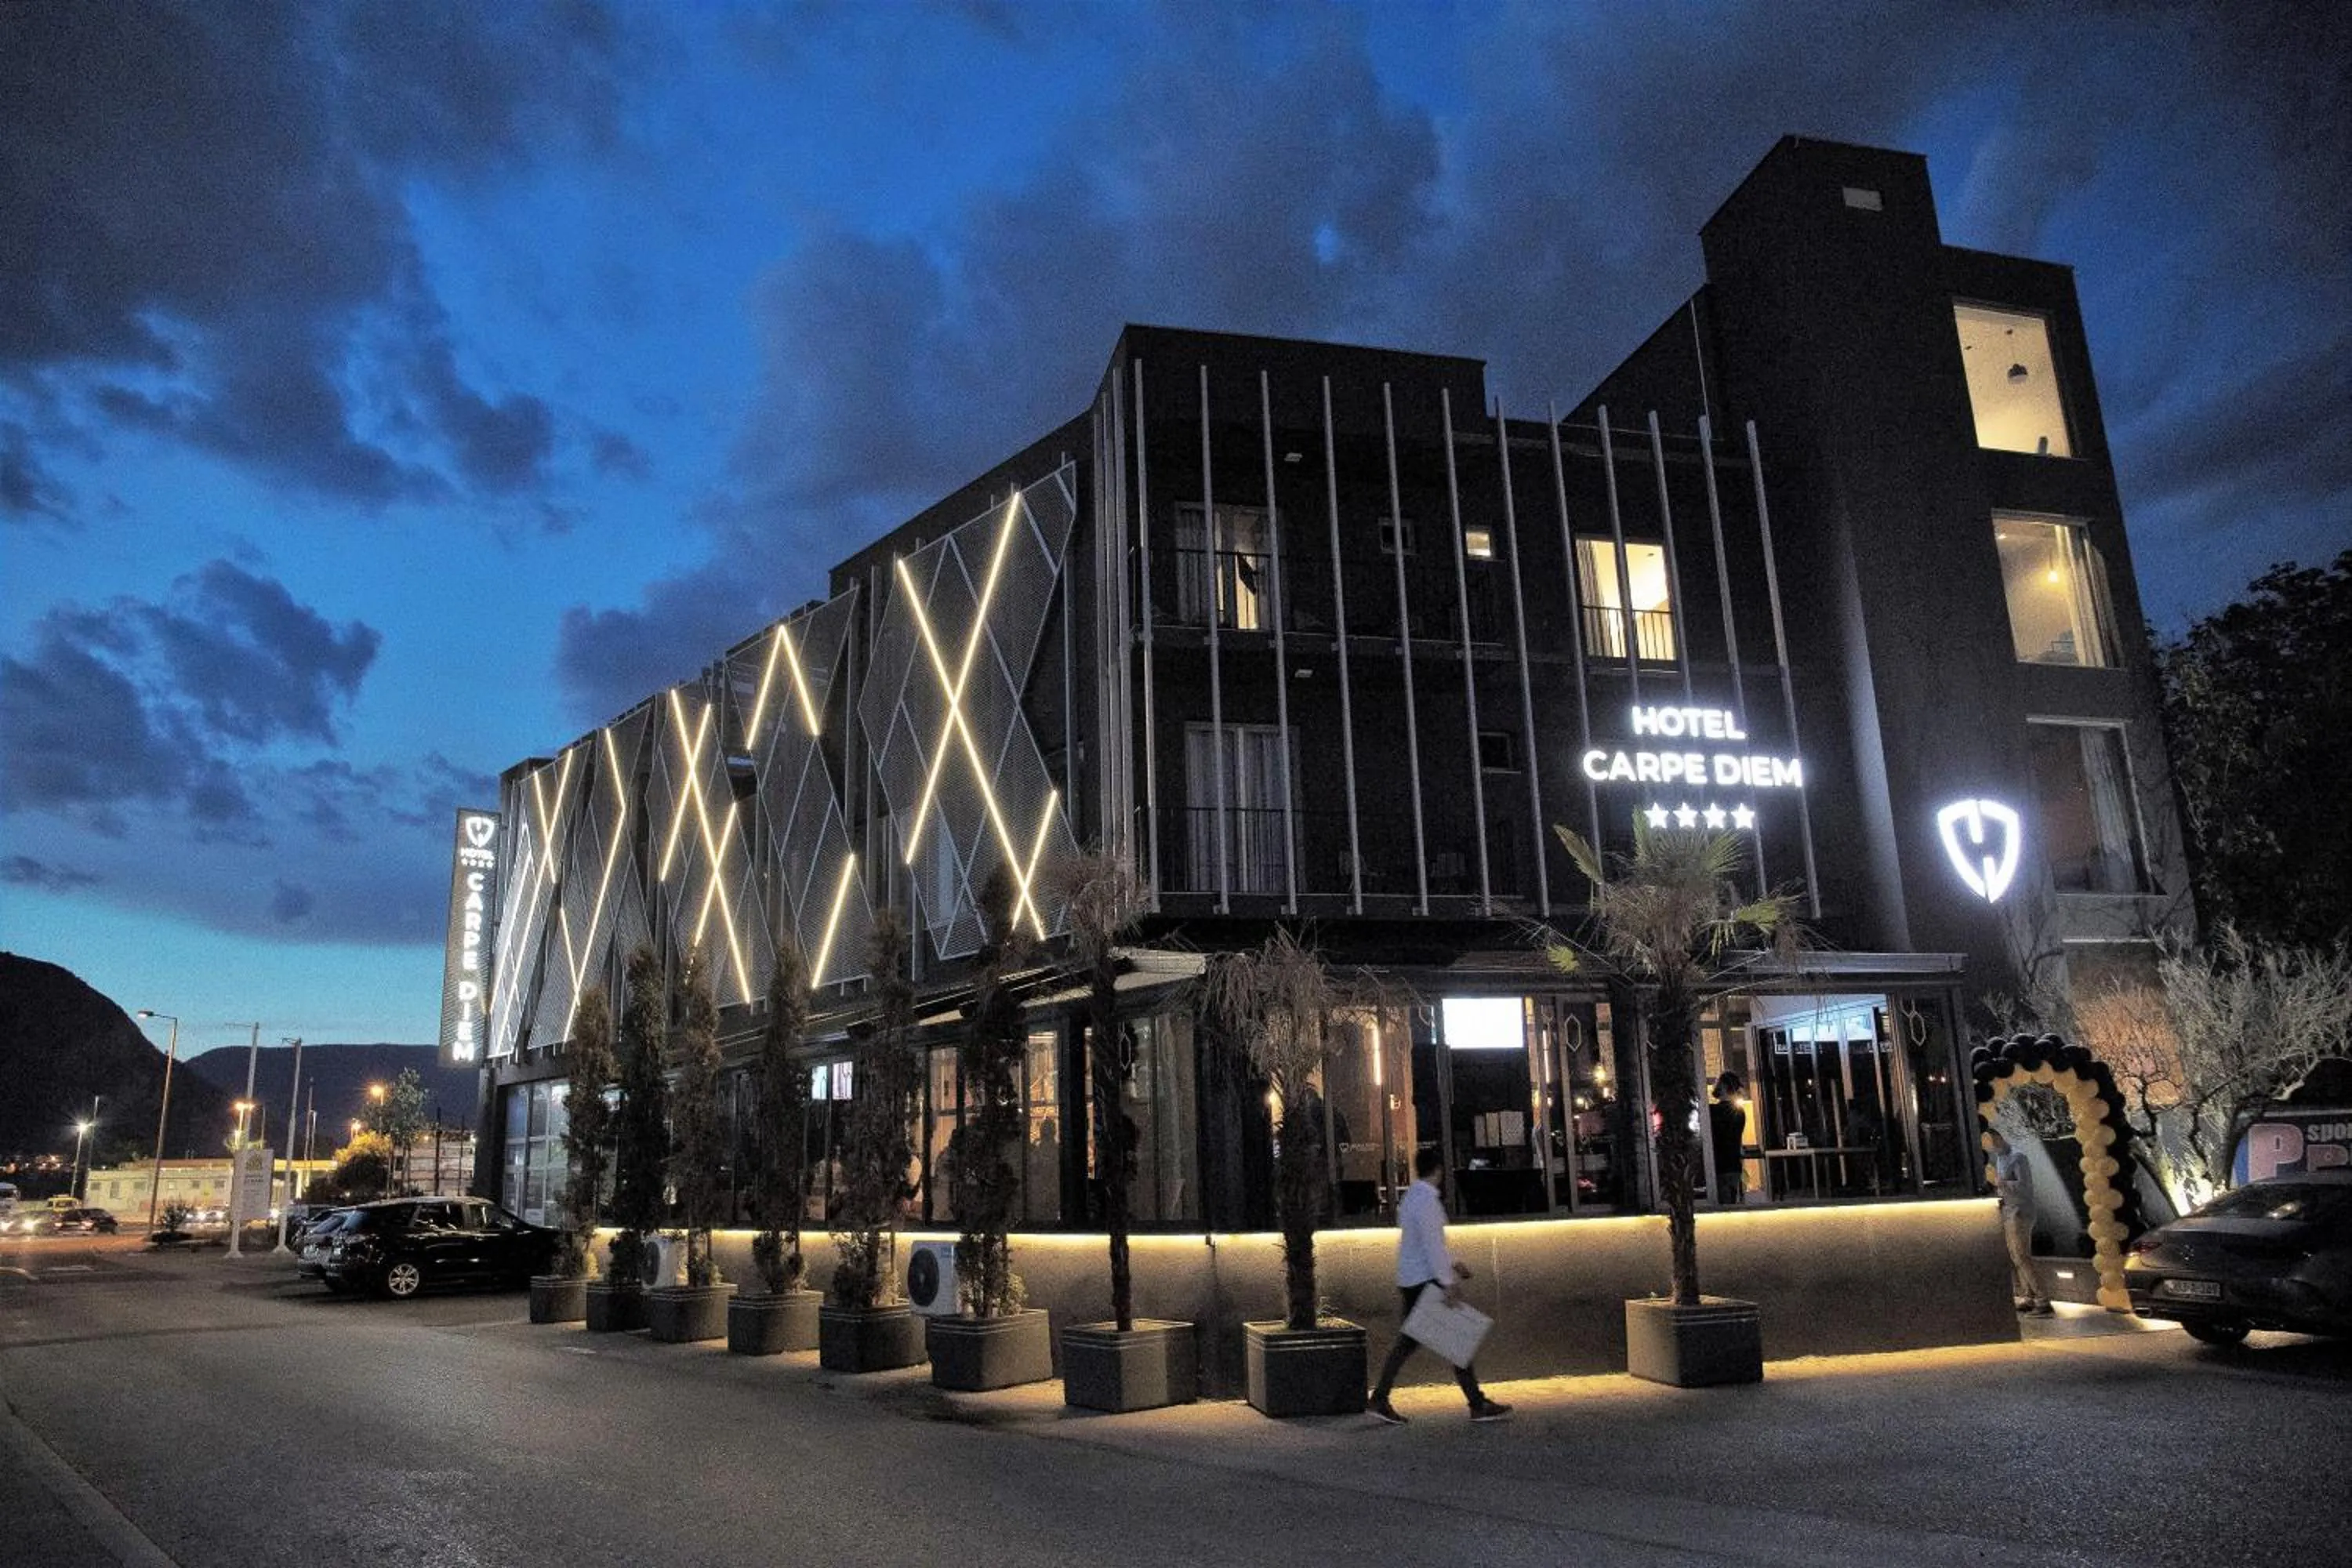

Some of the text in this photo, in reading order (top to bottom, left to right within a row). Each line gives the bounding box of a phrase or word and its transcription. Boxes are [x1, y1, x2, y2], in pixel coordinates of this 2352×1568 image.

[1632, 706, 1746, 739] HOTEL
[1583, 750, 1802, 788] CARPE DIEM
[452, 873, 485, 1061] CARPE DIEM
